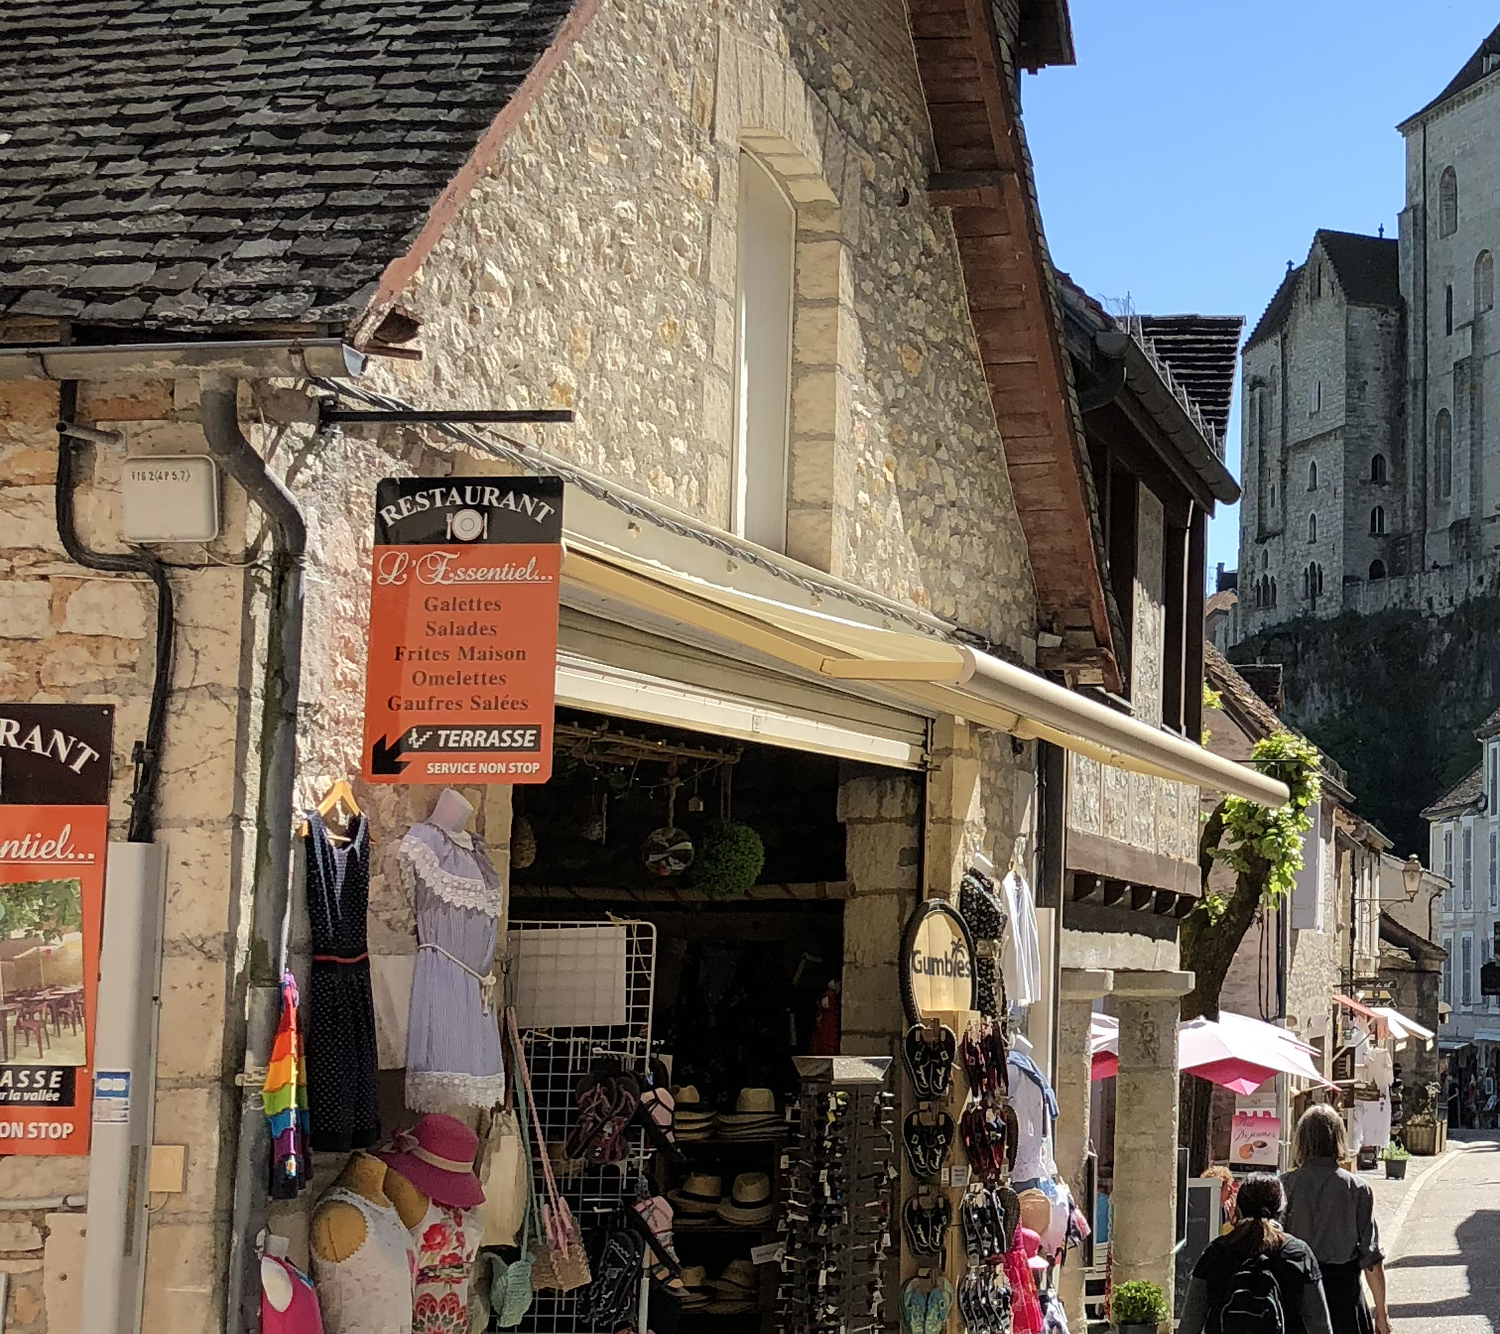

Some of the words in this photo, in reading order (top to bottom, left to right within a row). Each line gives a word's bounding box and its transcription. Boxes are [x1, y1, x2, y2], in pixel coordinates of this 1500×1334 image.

[379, 485, 555, 528] RESTAURANT
[424, 596, 502, 612] Galettes
[425, 620, 497, 637] Salades
[394, 645, 450, 661] Frites
[457, 645, 527, 661] Maison
[412, 670, 507, 687] Omelettes
[387, 695, 464, 711] Gaufres
[470, 694, 529, 711] Salées
[437, 729, 538, 748] TERRASSE
[426, 762, 477, 774] SERVICE
[478, 762, 507, 774] NON
[508, 762, 541, 774] STOP
[912, 949, 971, 979] Gumbies
[8, 1089, 21, 1101] la
[23, 1089, 61, 1101] vallée
[26, 1121, 74, 1139] STOP
